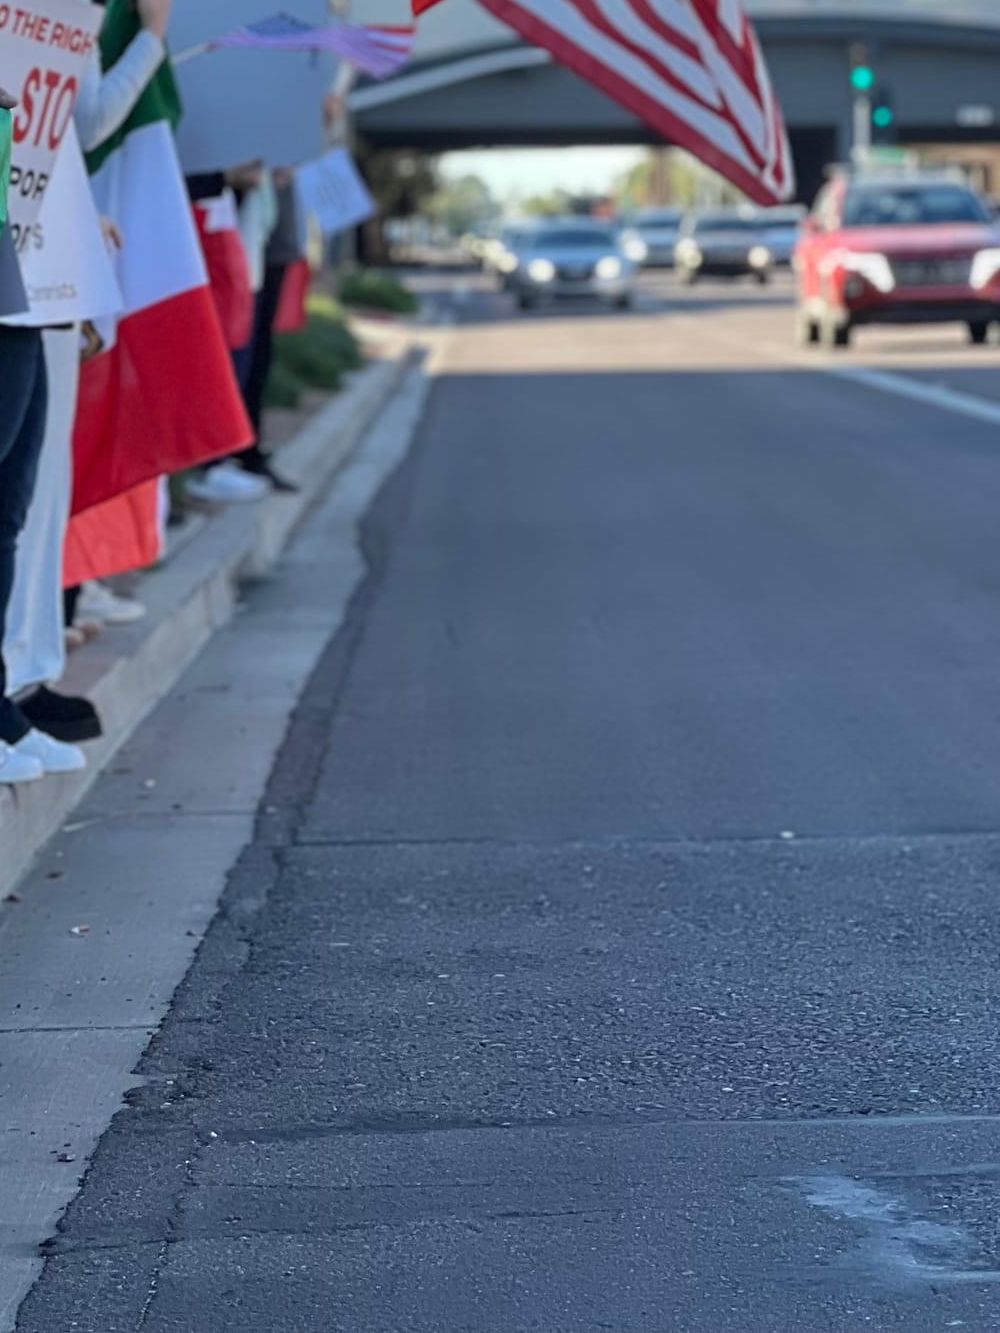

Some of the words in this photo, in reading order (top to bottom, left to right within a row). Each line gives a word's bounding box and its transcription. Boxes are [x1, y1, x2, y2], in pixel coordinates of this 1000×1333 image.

[11, 8, 50, 43] THE
[49, 21, 94, 57] RIGH
[12, 67, 77, 151] STO
